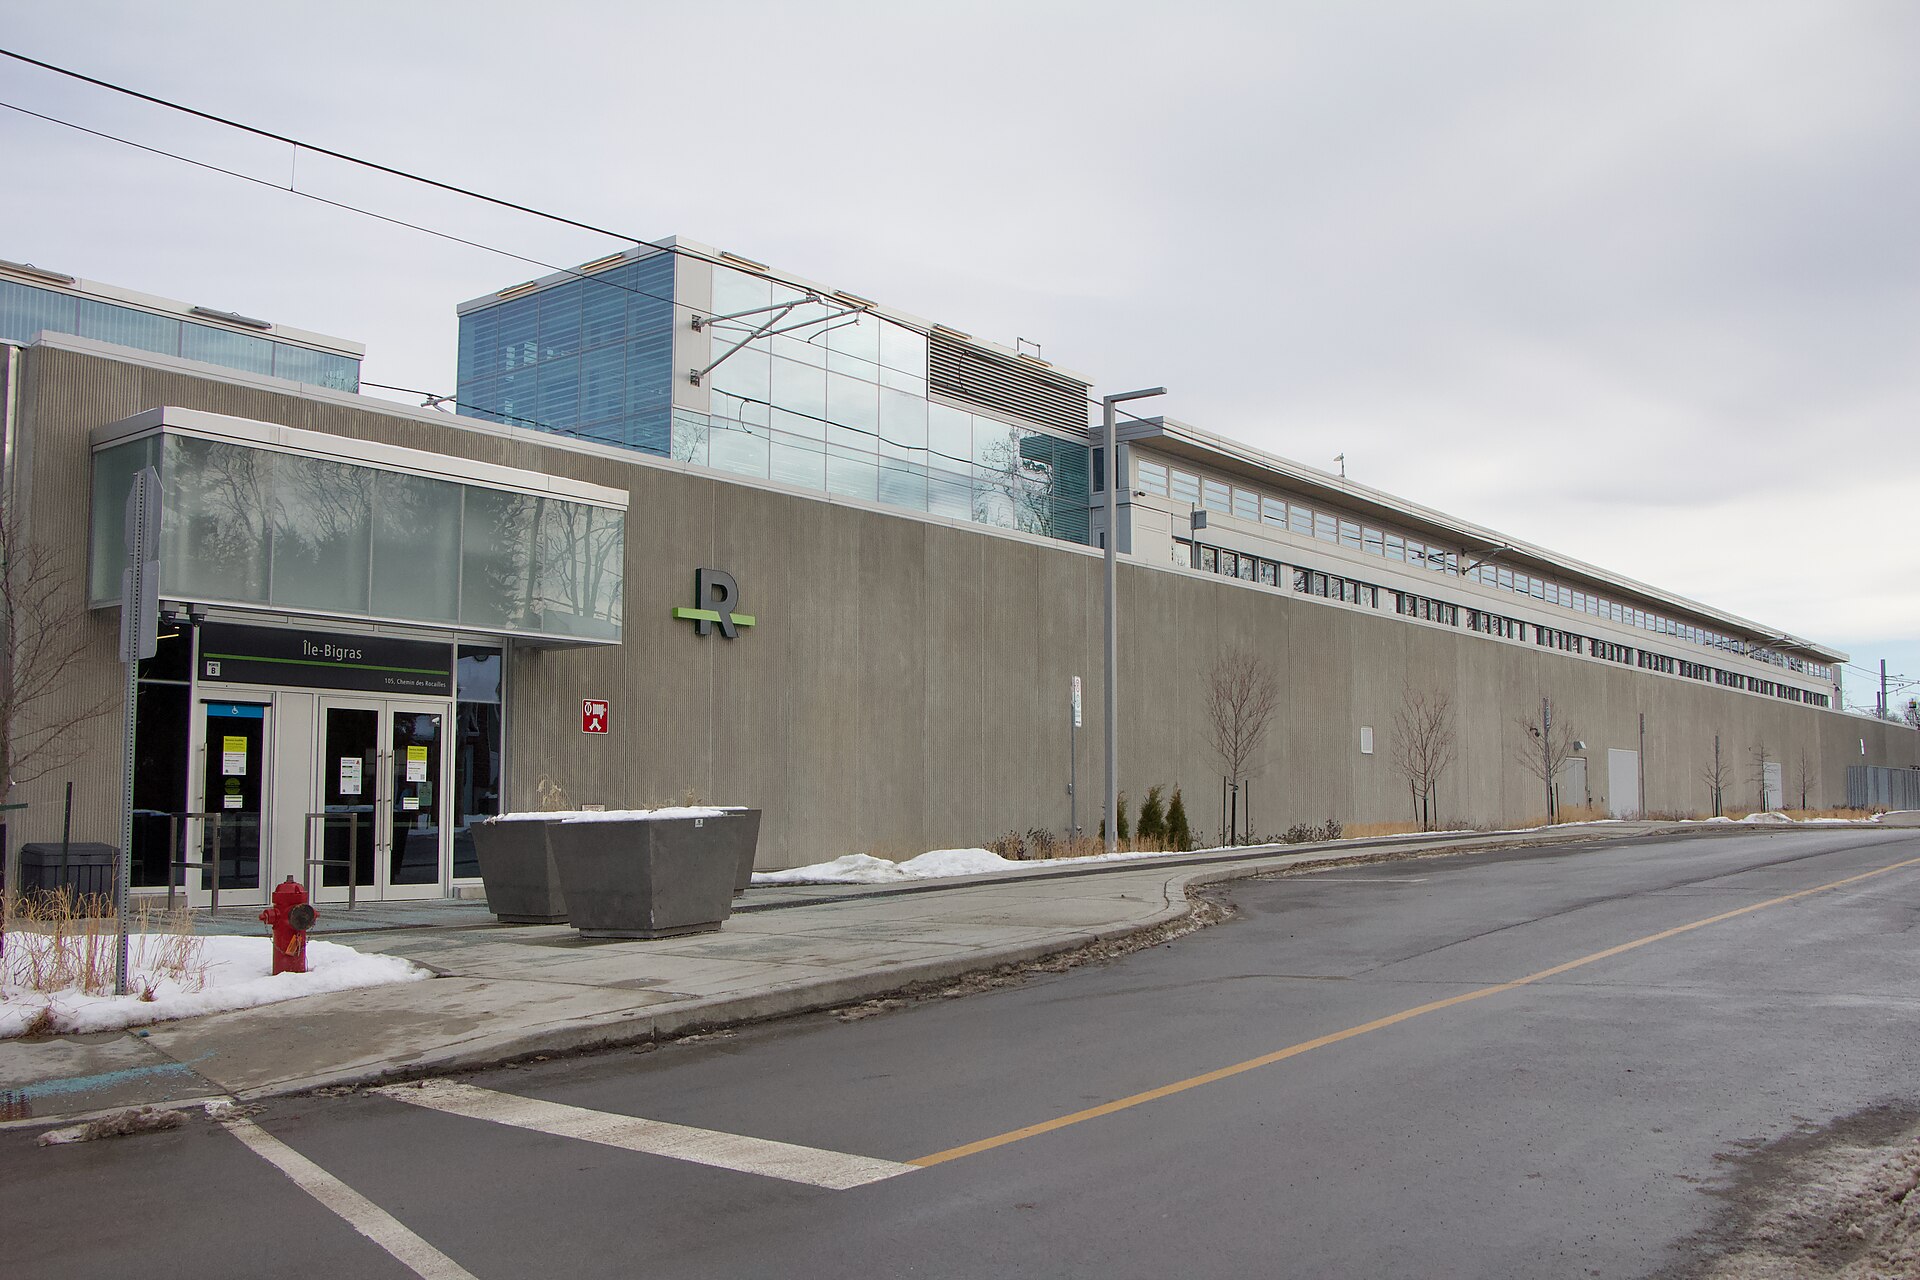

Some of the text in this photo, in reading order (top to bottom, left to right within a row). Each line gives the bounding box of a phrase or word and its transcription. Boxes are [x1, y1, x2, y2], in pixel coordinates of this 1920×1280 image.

[695, 568, 739, 639] R
[303, 639, 362, 661] Île-Bigras
[396, 678, 415, 686] Chemin
[425, 680, 447, 688] Rocailles
